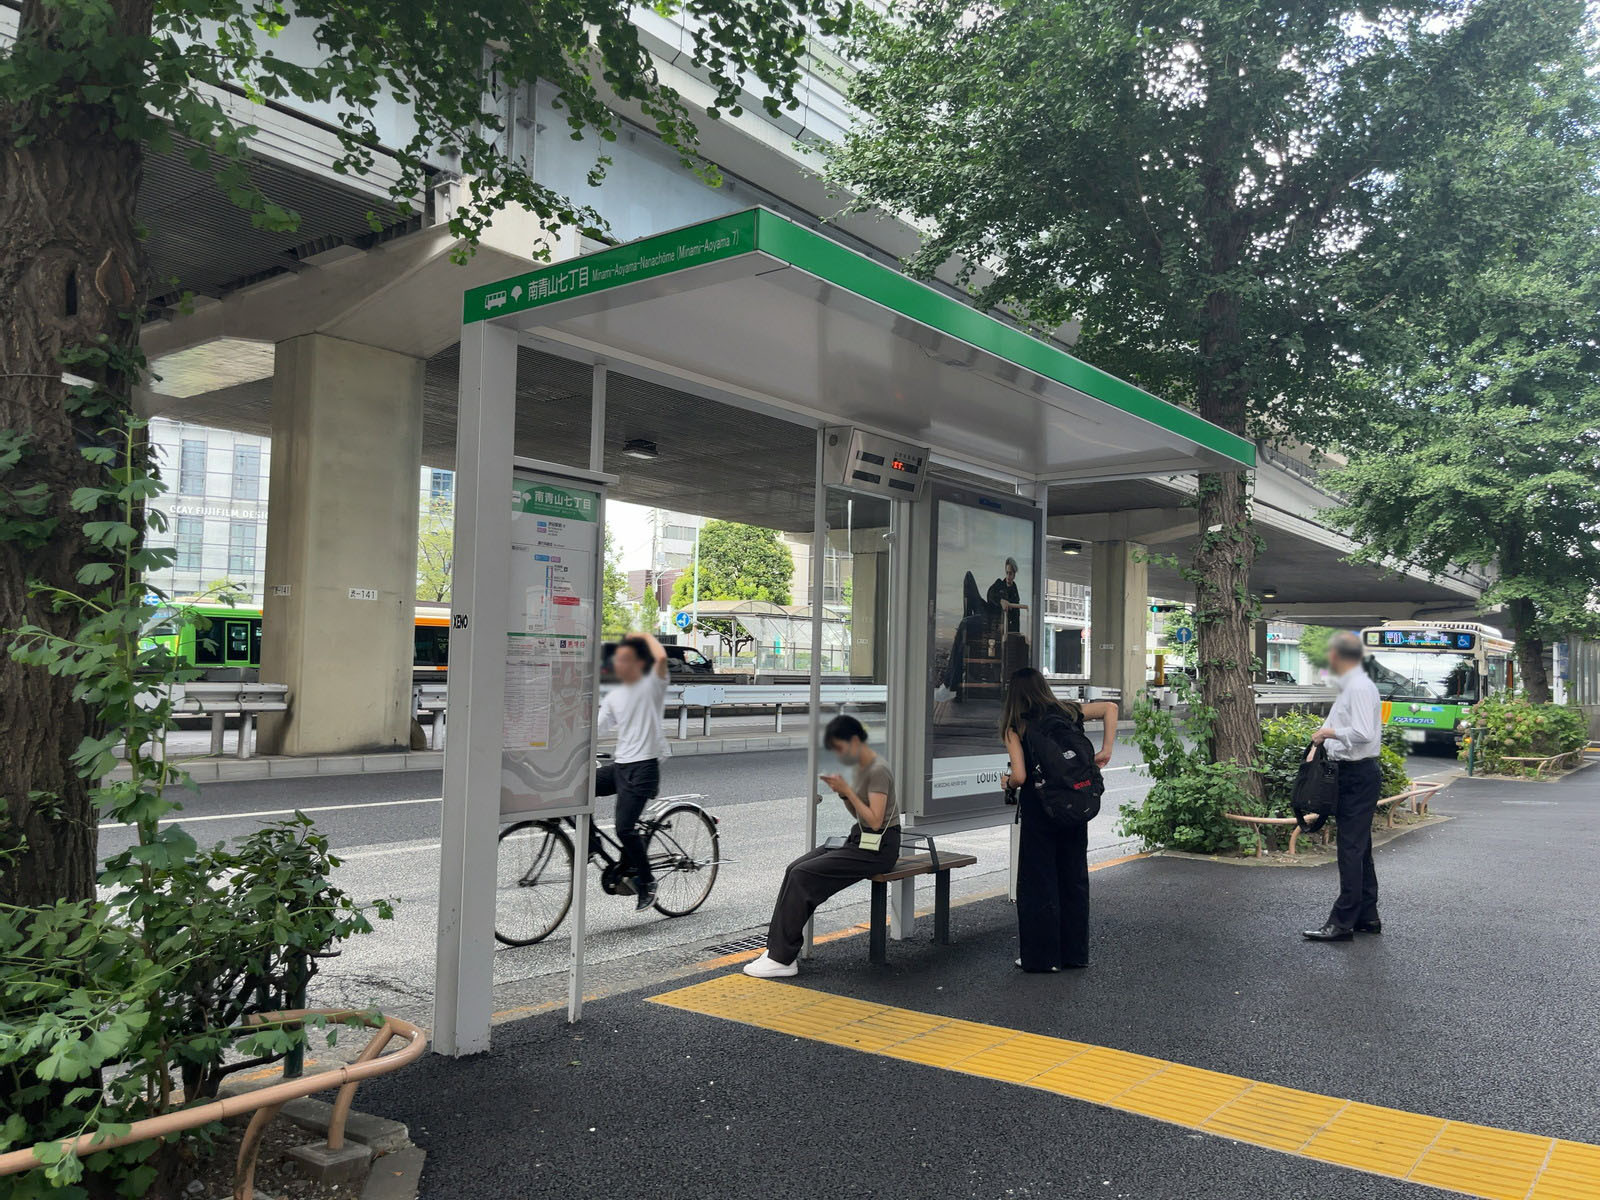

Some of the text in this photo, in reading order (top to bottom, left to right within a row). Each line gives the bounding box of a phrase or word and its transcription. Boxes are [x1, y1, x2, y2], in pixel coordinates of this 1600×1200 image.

[677, 237, 730, 259] (Minami-Aoyama
[732, 229, 740, 247] 7)
[528, 266, 589, 301] 南青山七丁目
[534, 490, 591, 510] 南青山七丁目
[169, 505, 194, 515] CLAY
[195, 506, 240, 518] FUJIFILM
[976, 772, 998, 784] LOUIS
